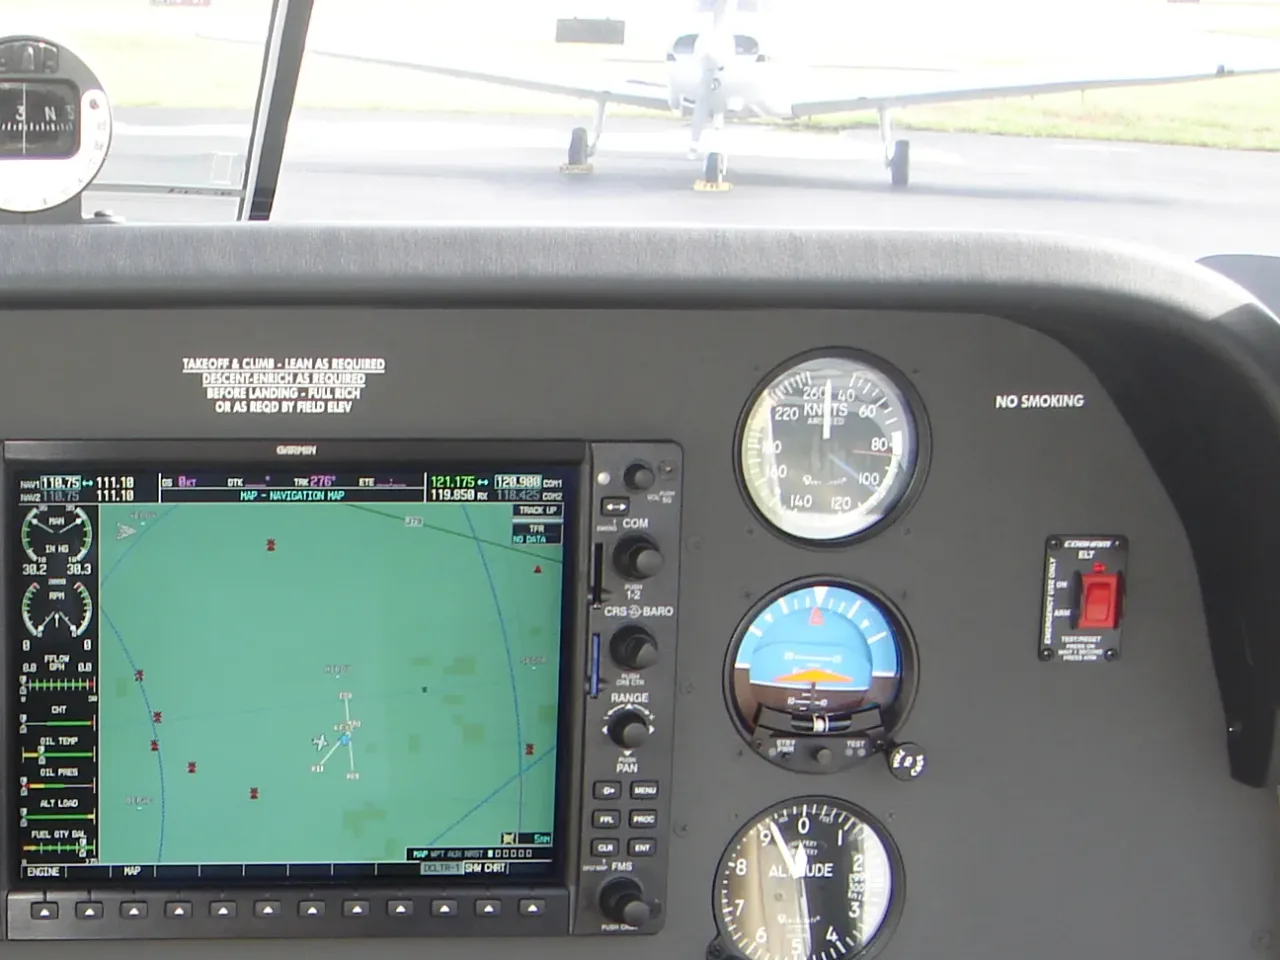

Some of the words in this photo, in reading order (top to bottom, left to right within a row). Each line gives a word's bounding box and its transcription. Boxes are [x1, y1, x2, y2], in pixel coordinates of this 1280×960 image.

[16, 106, 24, 120] 3
[45, 106, 56, 121] N
[183, 358, 228, 370] TAKEOFF
[230, 359, 239, 370] &
[242, 358, 274, 370] CLIMB
[286, 358, 311, 370] LEAN
[314, 358, 328, 370] AS
[332, 358, 385, 370] REQUIRED
[202, 373, 291, 385] DESCENT-ENRICH
[294, 373, 309, 384] AS
[311, 373, 365, 385] REQUIRED
[207, 387, 244, 399] BEFORE
[247, 387, 297, 399] LANDING
[308, 387, 332, 399] FULL
[334, 387, 360, 399] RICH
[838, 389, 855, 402] 40
[216, 401, 231, 413] OR
[233, 401, 248, 413] AS
[250, 401, 278, 414] REQD
[280, 401, 294, 413] BY
[297, 401, 324, 413] FIELD
[326, 401, 351, 413] ELEV
[996, 395, 1018, 408] NO
[1021, 394, 1084, 408] SMOKING
[775, 406, 799, 420] 220
[859, 405, 876, 418] 60
[277, 446, 316, 455] GARMIN
[871, 438, 888, 451] 80
[42, 478, 80, 489] 110.75
[431, 475, 475, 488] 121.175
[858, 472, 880, 485] 100
[43, 490, 79, 501] 110.75
[240, 491, 258, 501] MAP
[270, 490, 324, 500] NAVIGATION
[327, 490, 345, 500] MAP
[431, 488, 475, 501] 119.850
[790, 494, 812, 509] 140
[831, 496, 852, 510] 120
[520, 505, 544, 515] TRACK
[547, 505, 557, 515] UP
[623, 518, 648, 528] COM
[1078, 550, 1094, 560] ELT
[604, 606, 627, 617] CRS
[643, 606, 673, 616] BARO
[611, 692, 648, 702] RANGE
[846, 739, 865, 748] TEST
[616, 763, 637, 773] PAN
[635, 786, 656, 795] MENU
[798, 817, 809, 834] 0
[761, 830, 771, 847] 9
[635, 843, 649, 852] ENT
[484, 862, 505, 872] CHRT
[612, 862, 632, 872] FMS
[736, 858, 747, 875] 8
[853, 854, 863, 871] 2
[27, 868, 59, 876] ENGINE
[735, 900, 744, 916] 7
[849, 902, 860, 918] 3
[756, 927, 767, 943] 6
[826, 926, 838, 942] 4
[792, 938, 802, 954] 5
